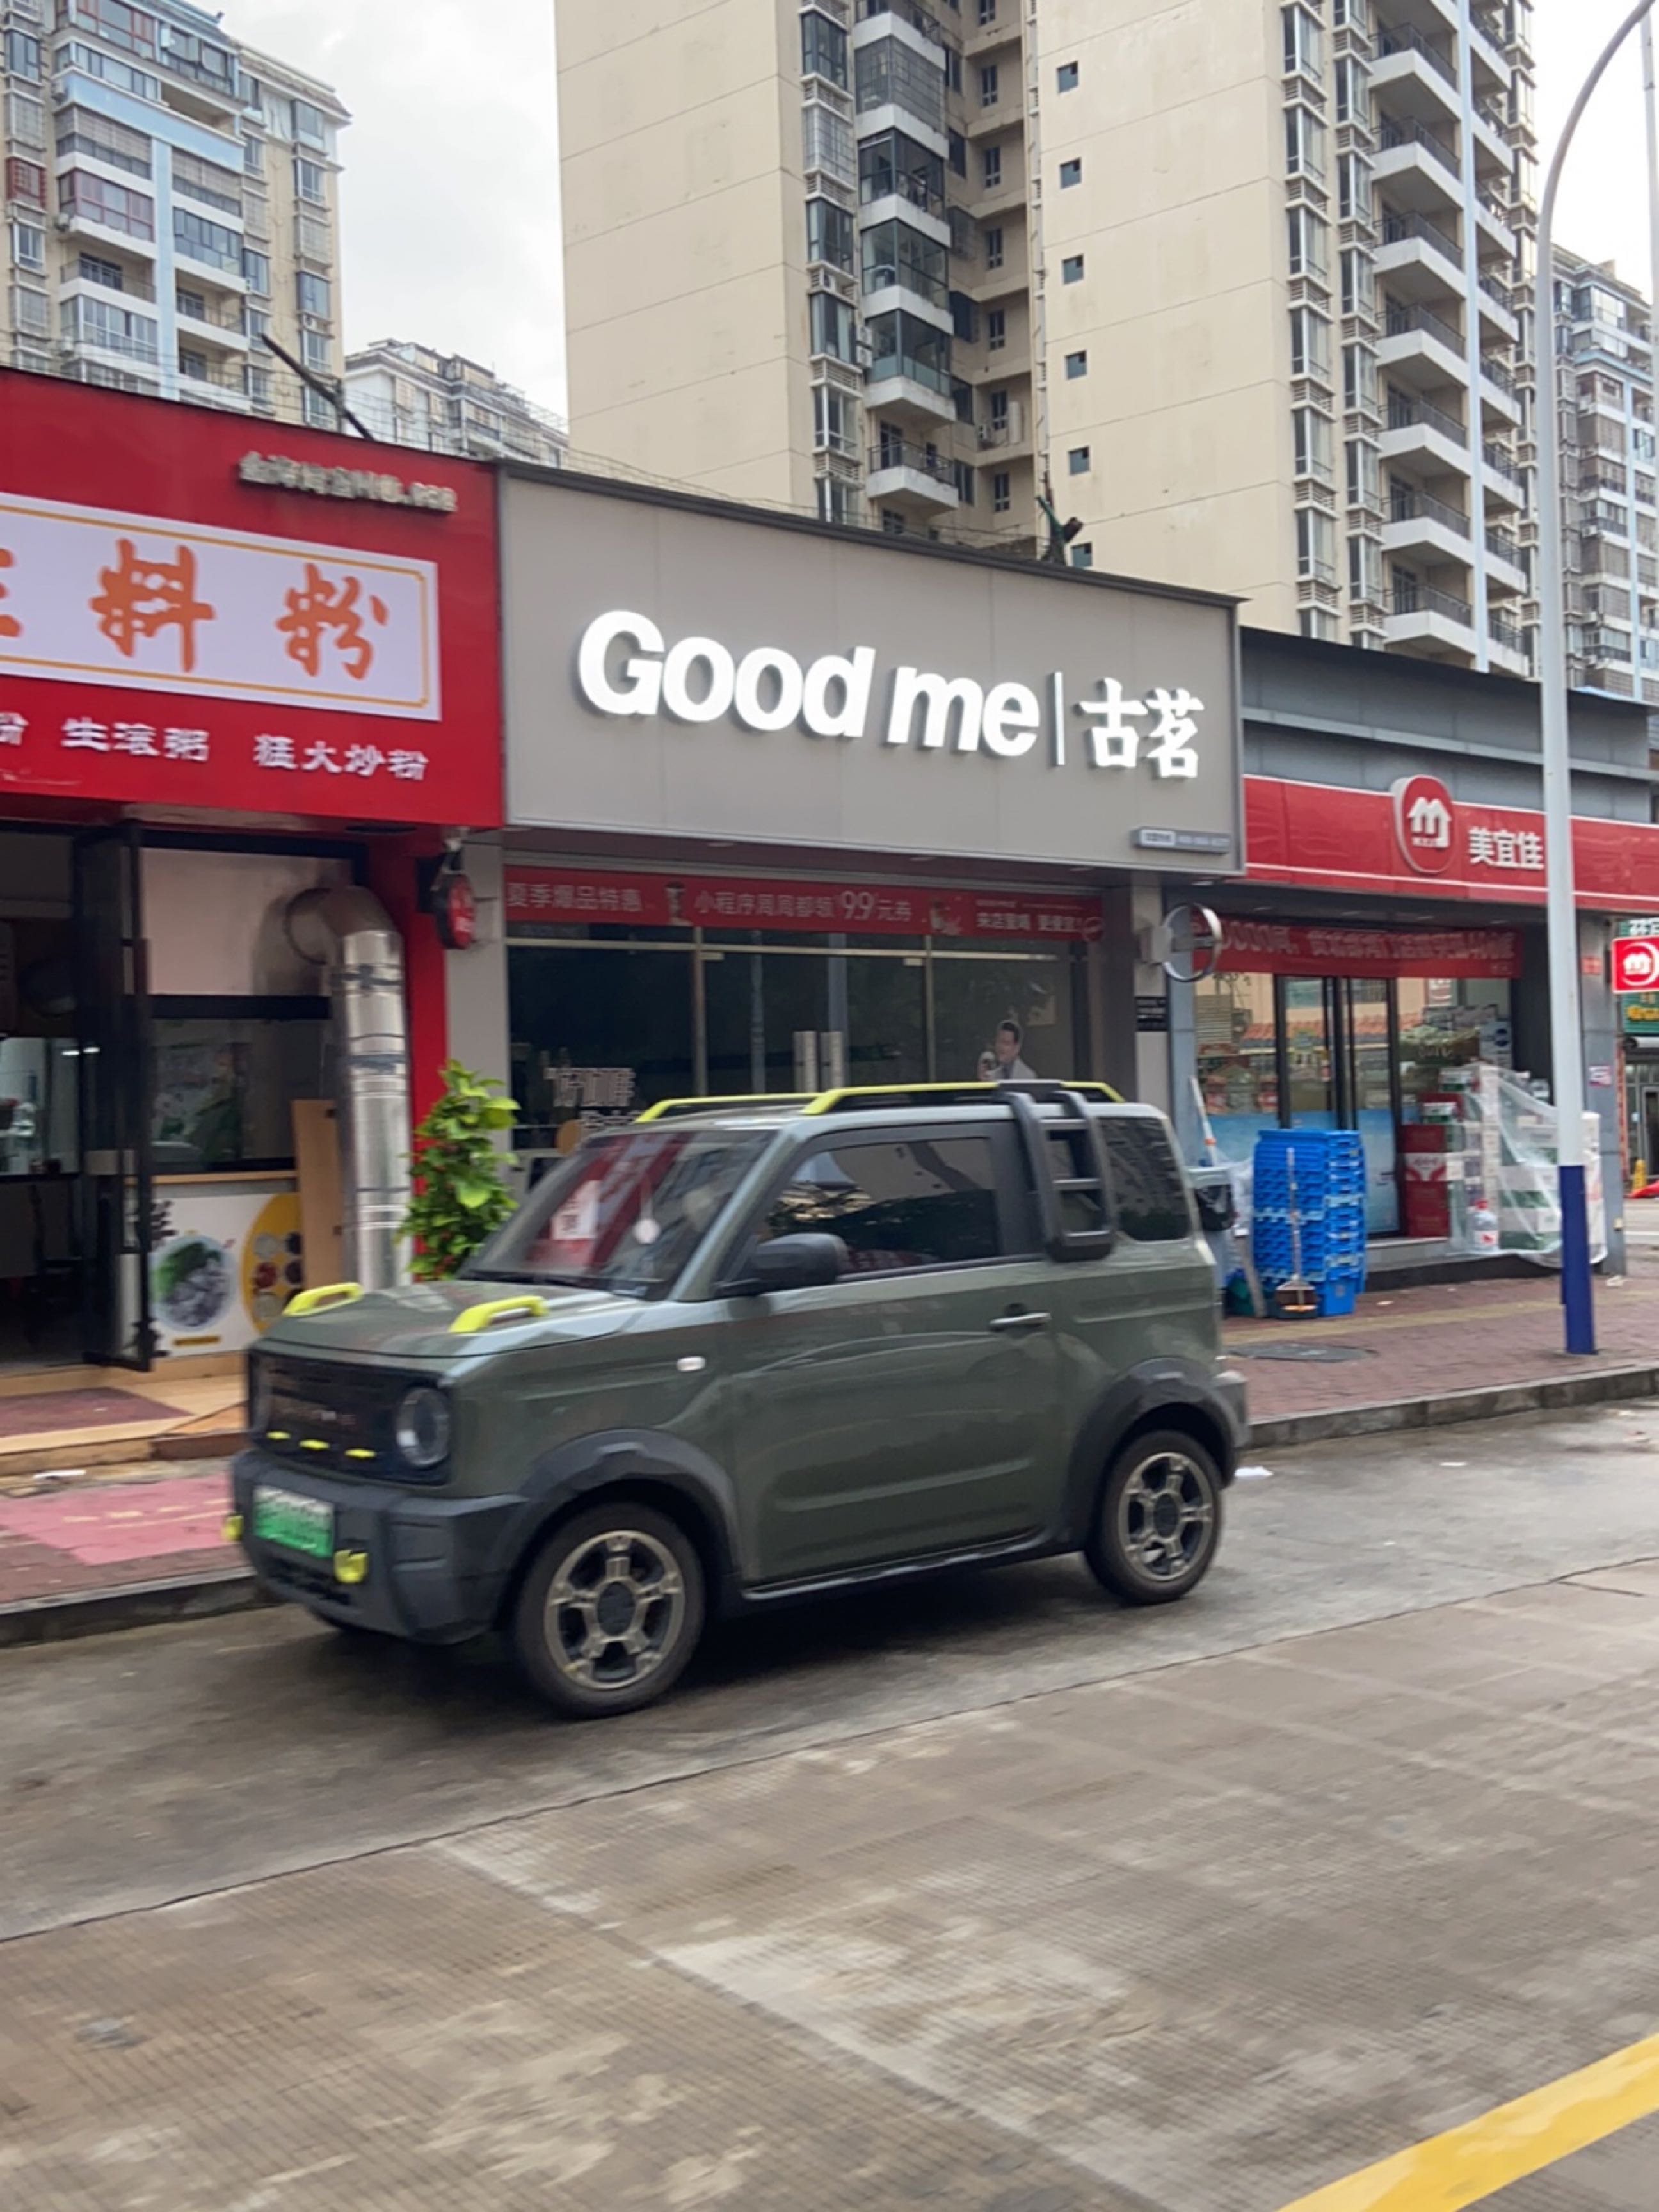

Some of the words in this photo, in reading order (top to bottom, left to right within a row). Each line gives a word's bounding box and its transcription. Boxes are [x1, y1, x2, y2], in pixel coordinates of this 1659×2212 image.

[0, 538, 389, 680] 料粉
[579, 609, 876, 738] Good
[887, 666, 1040, 757] me
[1079, 677, 1205, 778] 古茗
[1468, 825, 1544, 870] 美宜佳
